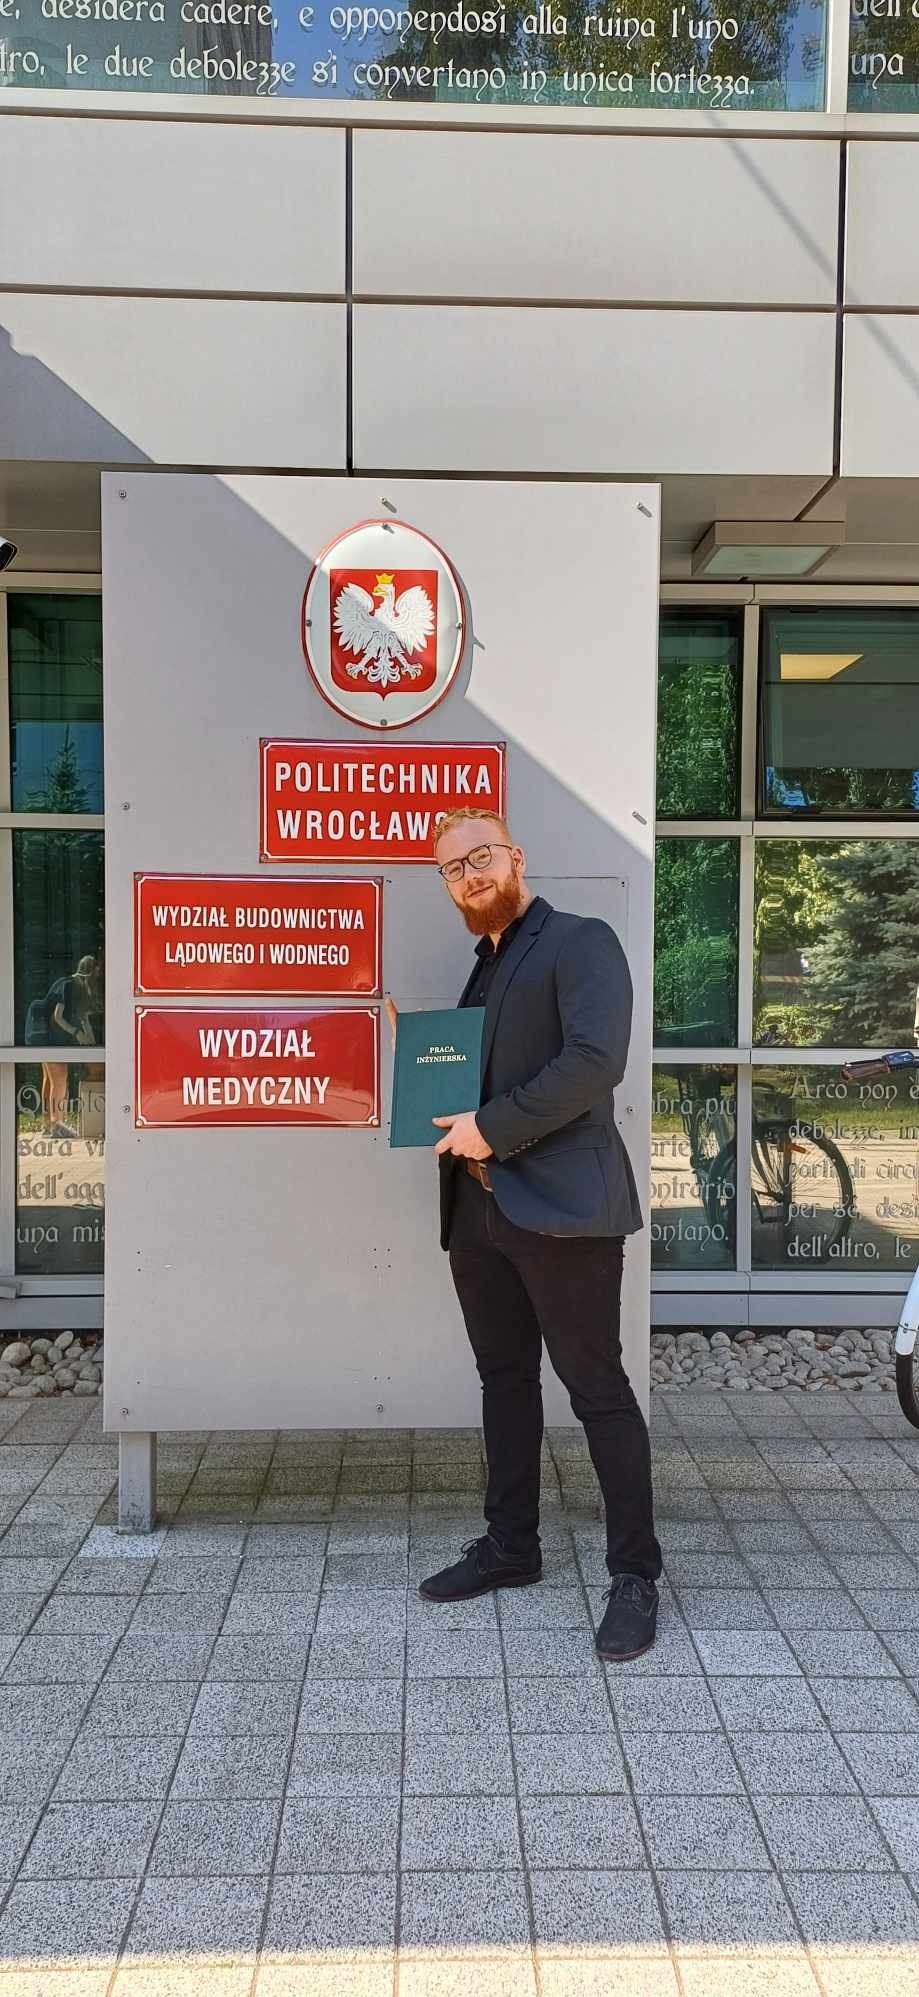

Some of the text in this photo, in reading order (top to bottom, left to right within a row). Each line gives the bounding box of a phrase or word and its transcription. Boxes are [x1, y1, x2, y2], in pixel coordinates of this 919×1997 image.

[41, 0, 165, 22] desidera
[180, 0, 278, 29] cadere,
[299, 6, 314, 28] e
[329, 0, 506, 45] opponendosi
[522, 3, 567, 35] alla
[583, 7, 656, 50] ruina
[671, 5, 739, 51] l'uno
[66, 44, 89, 75] le
[104, 44, 154, 77] due
[169, 45, 296, 96] debolezze
[312, 50, 337, 84] si
[353, 59, 506, 101] convertano
[522, 61, 547, 103] in
[563, 63, 634, 105] unica
[649, 62, 755, 108] fortezza.
[851, 53, 904, 90] una
[275, 762, 492, 795] POLITECHNIKA
[152, 905, 365, 930] WYDZIAŁ BUDOWNICTWA
[165, 942, 350, 968] LĄDOWEGO I WODNEGO
[416, 1054, 467, 1064] INŻYNIERSKA
[429, 1046, 455, 1054] PRACA
[182, 1028, 331, 1106] WYDZIAŁ MEDYCZNY
[788, 1073, 848, 1099] Arco
[860, 1082, 898, 1109] non
[784, 1202, 818, 1227] per
[16, 1225, 59, 1255] una
[787, 1234, 913, 1260] dell'altro, le
